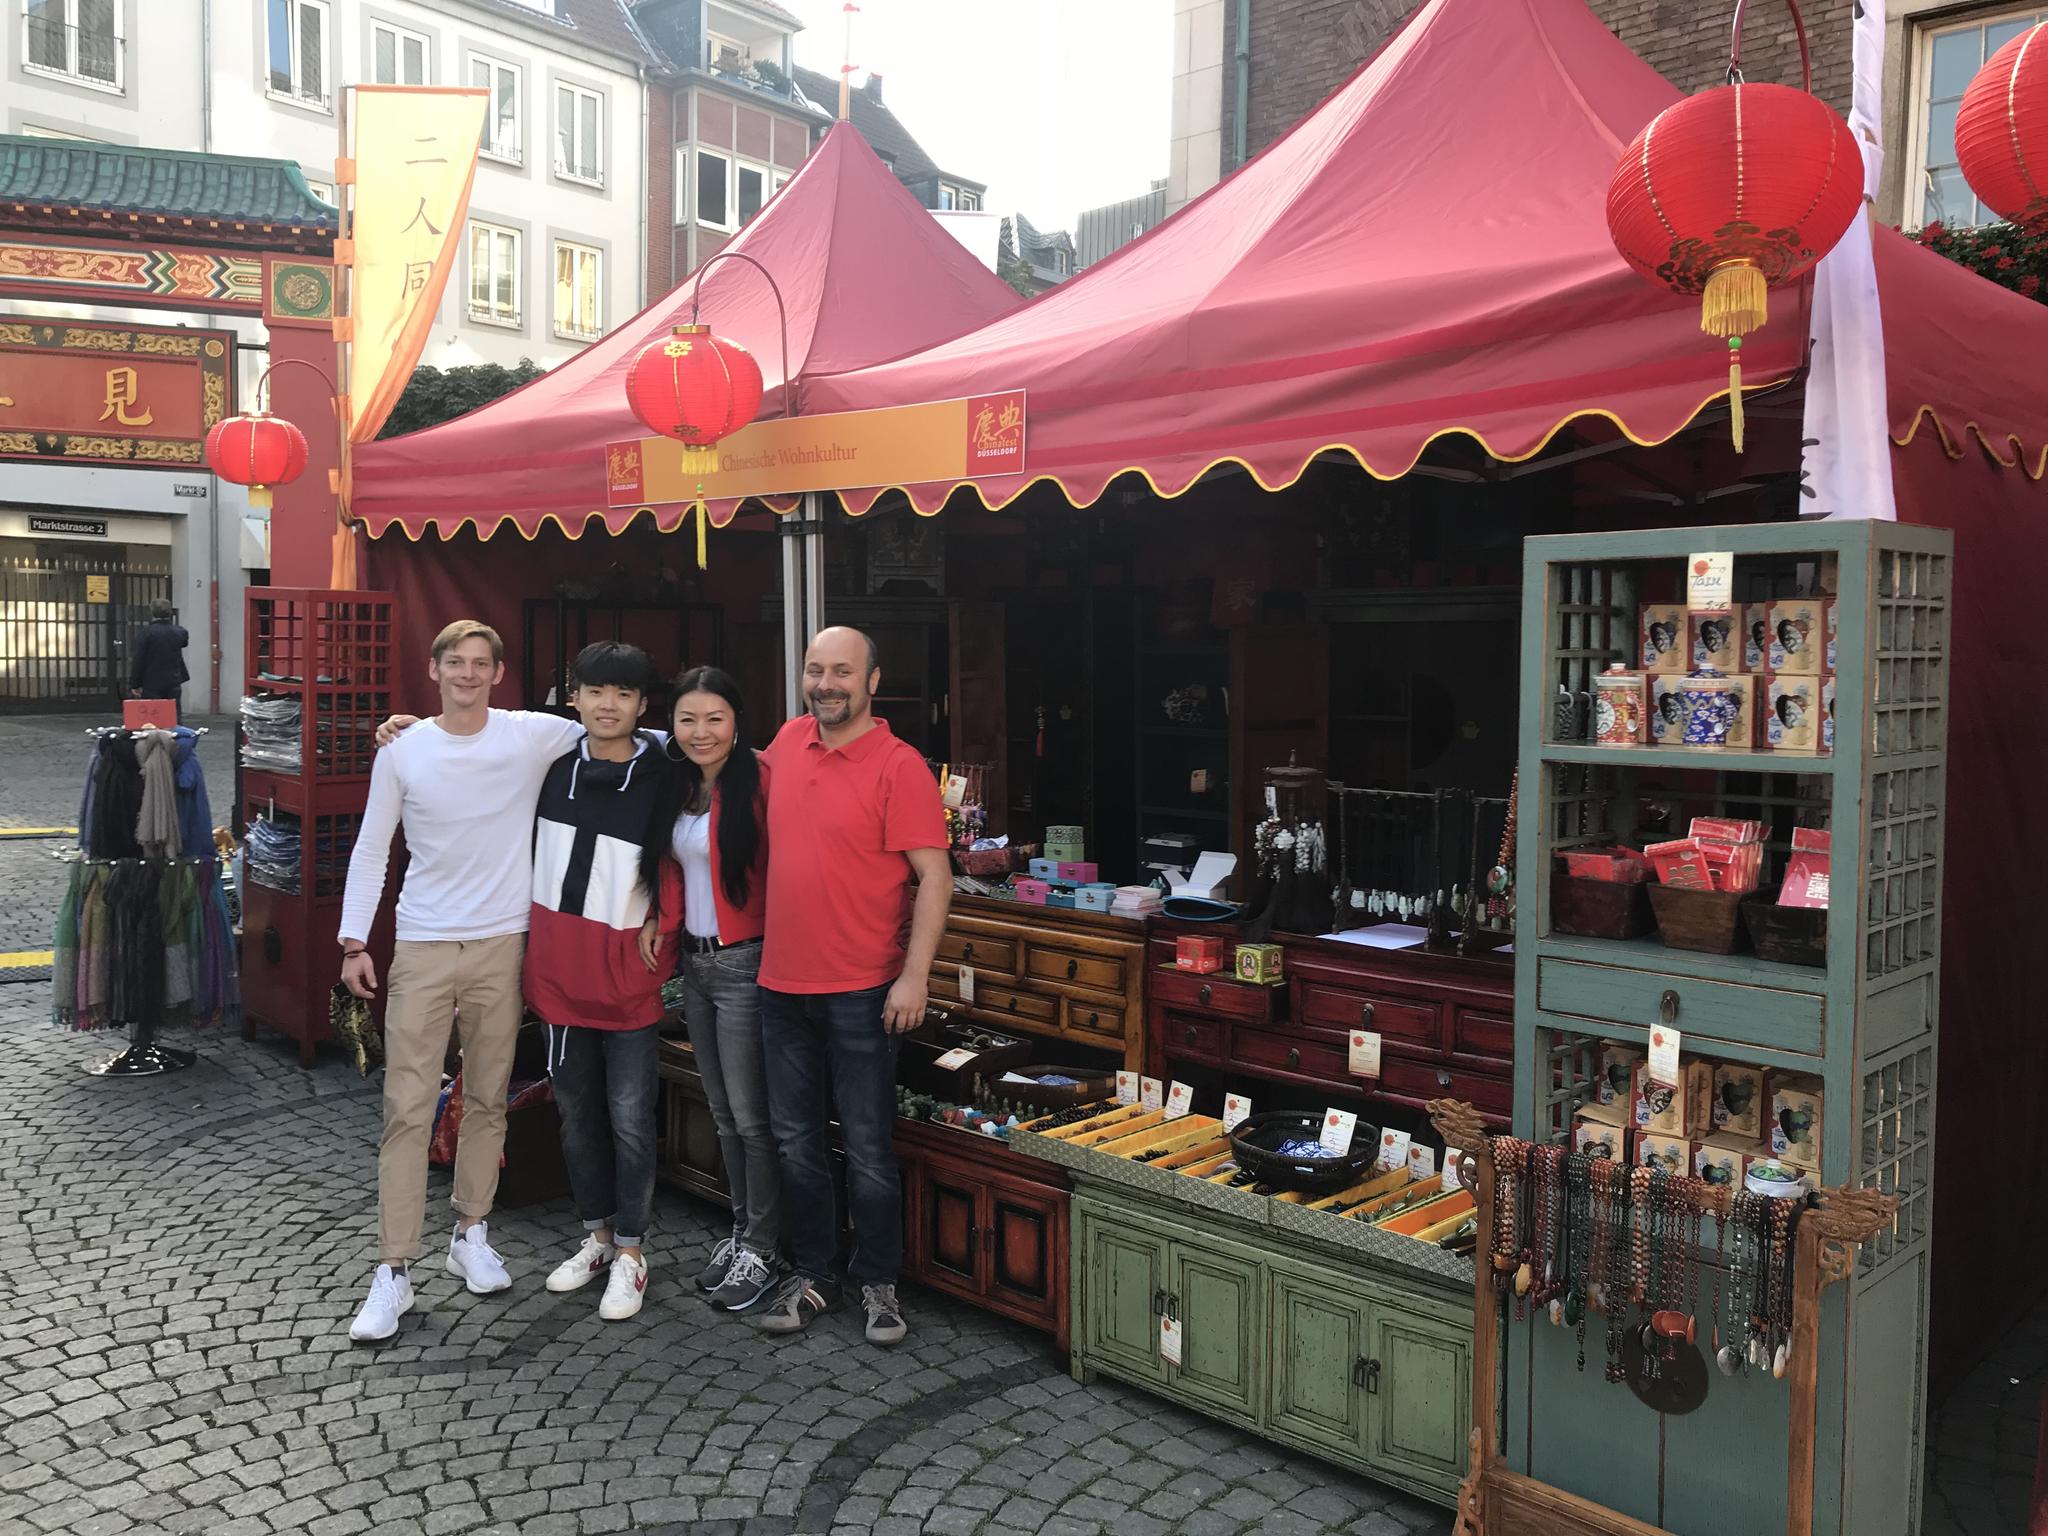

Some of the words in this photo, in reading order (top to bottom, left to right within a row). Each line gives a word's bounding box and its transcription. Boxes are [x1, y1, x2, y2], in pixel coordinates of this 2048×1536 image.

[382, 136, 449, 350] 二人同
[722, 449, 776, 472] Chinesische
[778, 442, 858, 465] Wohnkultur
[977, 446, 1017, 458] DÜSSELDORF
[32, 520, 95, 533] Marktstrasse
[97, 524, 104, 534] 2
[196, 579, 202, 588] 2
